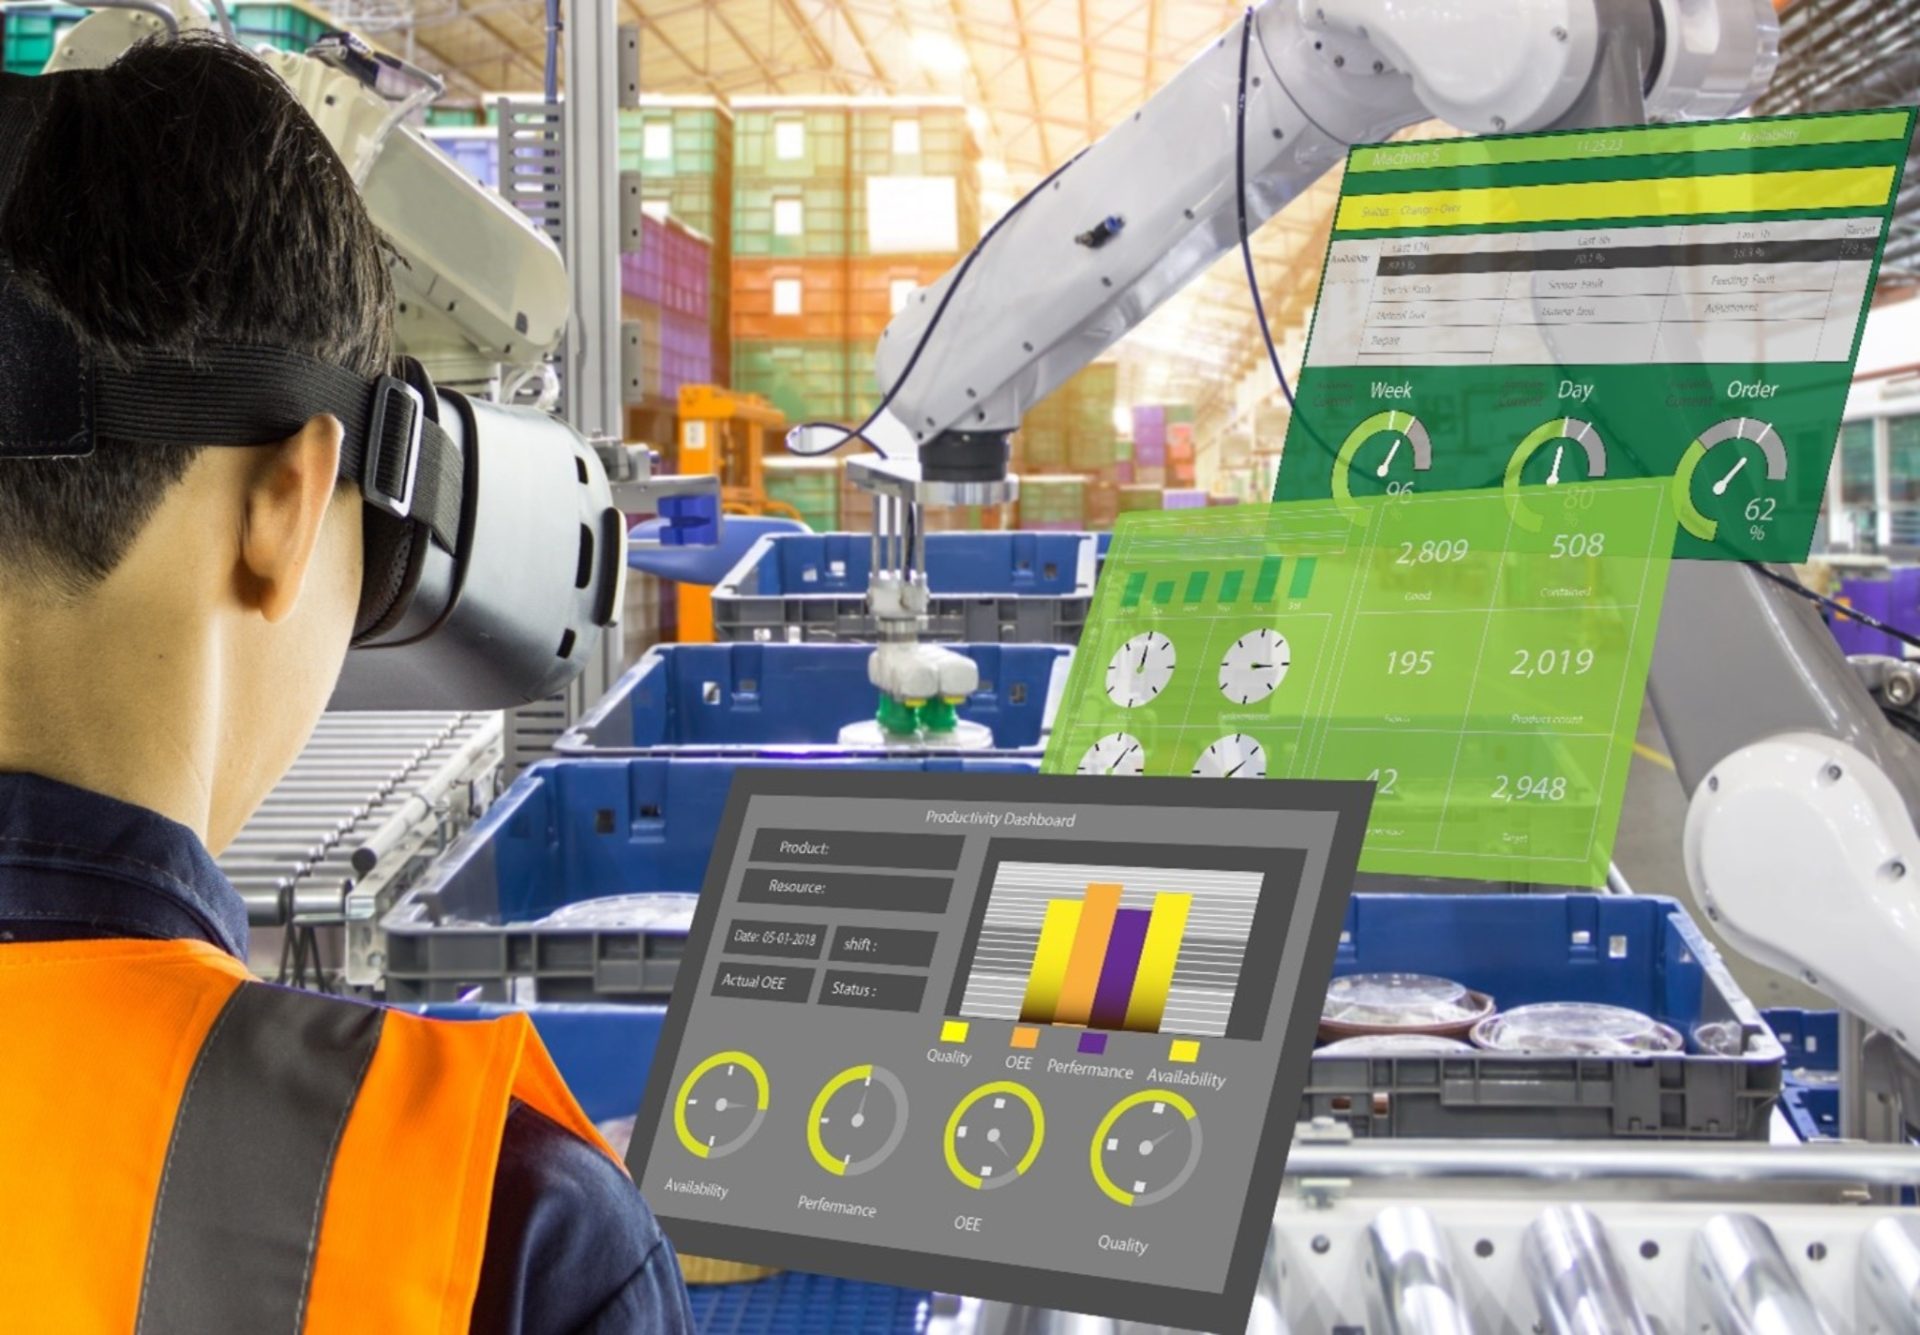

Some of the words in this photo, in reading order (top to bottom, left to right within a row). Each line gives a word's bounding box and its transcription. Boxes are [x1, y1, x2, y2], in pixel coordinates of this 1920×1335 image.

[1738, 128, 1798, 143] Availability
[1370, 380, 1413, 399] Week
[1557, 379, 1595, 402] Day
[1726, 379, 1780, 399] Order
[1744, 497, 1777, 521] 62
[1749, 524, 1766, 541] %
[1395, 538, 1470, 566] 2,809
[1549, 533, 1606, 559] 508
[1403, 590, 1434, 602] Good
[1387, 650, 1435, 675] 195
[1509, 649, 1595, 679] 2,019
[1490, 775, 1567, 803] 2,948
[925, 810, 1002, 827] Productivity
[1003, 812, 1076, 828] Dashboard
[780, 841, 829, 856] Product:
[768, 879, 826, 895] Resource:
[734, 930, 760, 944] Date:
[844, 937, 871, 952] shift
[721, 974, 759, 989] Actual
[760, 976, 787, 990] OEE
[832, 981, 868, 997] Status
[926, 1048, 972, 1067] Quality
[1005, 1055, 1033, 1070] OEE
[1146, 1067, 1227, 1090] Availability
[664, 1177, 729, 1201] Availability
[954, 1215, 983, 1232] OEE
[1098, 1234, 1149, 1257] Quality
